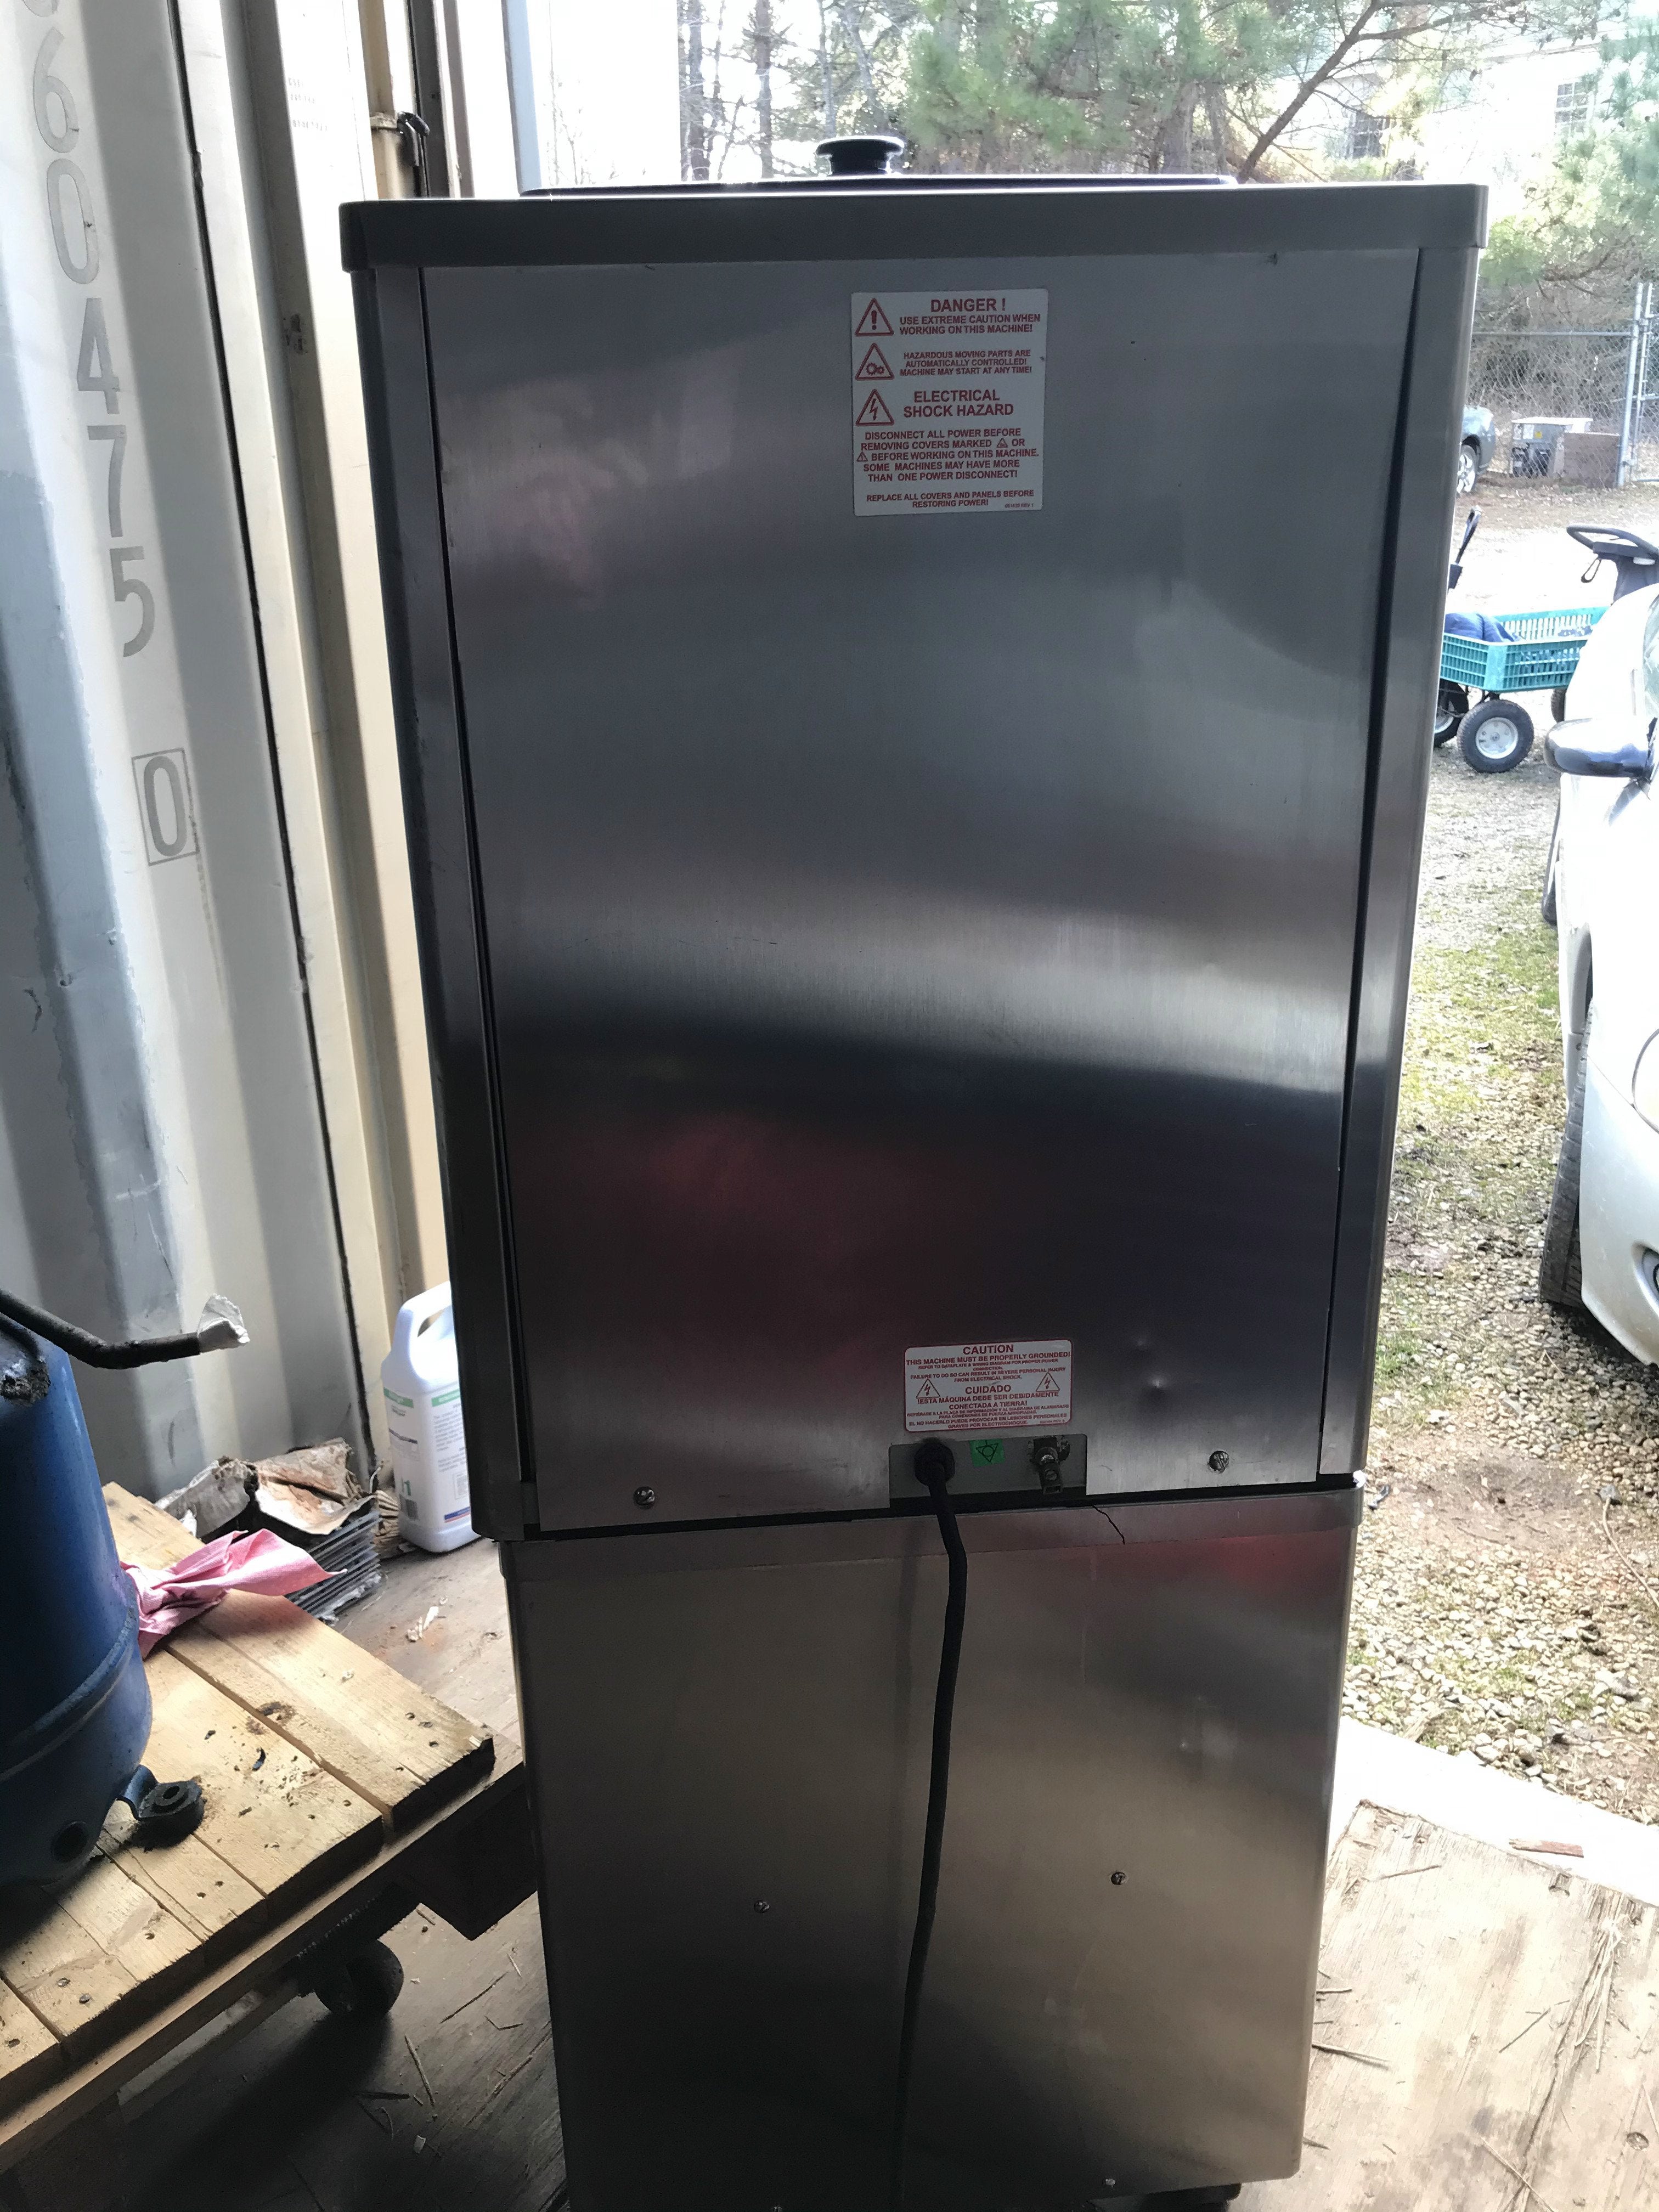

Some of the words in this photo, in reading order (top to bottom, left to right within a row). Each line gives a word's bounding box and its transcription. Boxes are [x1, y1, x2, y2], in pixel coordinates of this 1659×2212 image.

[931, 298, 996, 312] DANGER
[900, 317, 918, 325] USE
[921, 315, 966, 324] EXTREME
[969, 314, 1011, 323] CAUTION
[1013, 314, 1040, 322] WHEN
[900, 326, 945, 335] WORKING
[948, 326, 963, 334] ON
[965, 325, 985, 334] THIS
[987, 324, 1032, 333] MACHINE!
[904, 351, 953, 359] HAZARDOUS
[906, 359, 970, 368] AUTOMATICALLY
[972, 358, 1026, 366] CONTROLLED!
[914, 390, 1000, 403] ELECTRICAL
[904, 405, 953, 418] SHOCK
[957, 403, 1014, 416] HAZARD
[865, 431, 925, 440] DISCONNECT
[927, 430, 945, 438] ALL
[947, 429, 981, 438] POWER
[984, 428, 1021, 437] BEFORE
[861, 442, 910, 451] REMOVING
[912, 441, 950, 450] COVERS
[952, 440, 992, 449] MARKED
[1012, 438, 1025, 447] OR
[871, 452, 909, 461] BEFORE
[911, 451, 955, 460] WORKING
[958, 450, 972, 459] ON
[973, 450, 993, 458] THIS
[995, 449, 1039, 457] MACHINE.
[864, 463, 890, 472] SOME
[895, 462, 942, 471] MACHINES
[945, 461, 963, 470] MAY
[967, 460, 990, 469] HAVE
[868, 473, 893, 482] THAN
[898, 473, 917, 481] ONE
[919, 472, 953, 480] POWER
[956, 470, 1018, 479] DISCONNECT!
[867, 494, 902, 502] REPLACE
[912, 500, 956, 508] RESTORING
[963, 1345, 1014, 1355] CAUTION
[965, 1384, 1011, 1394] CUIDADO
